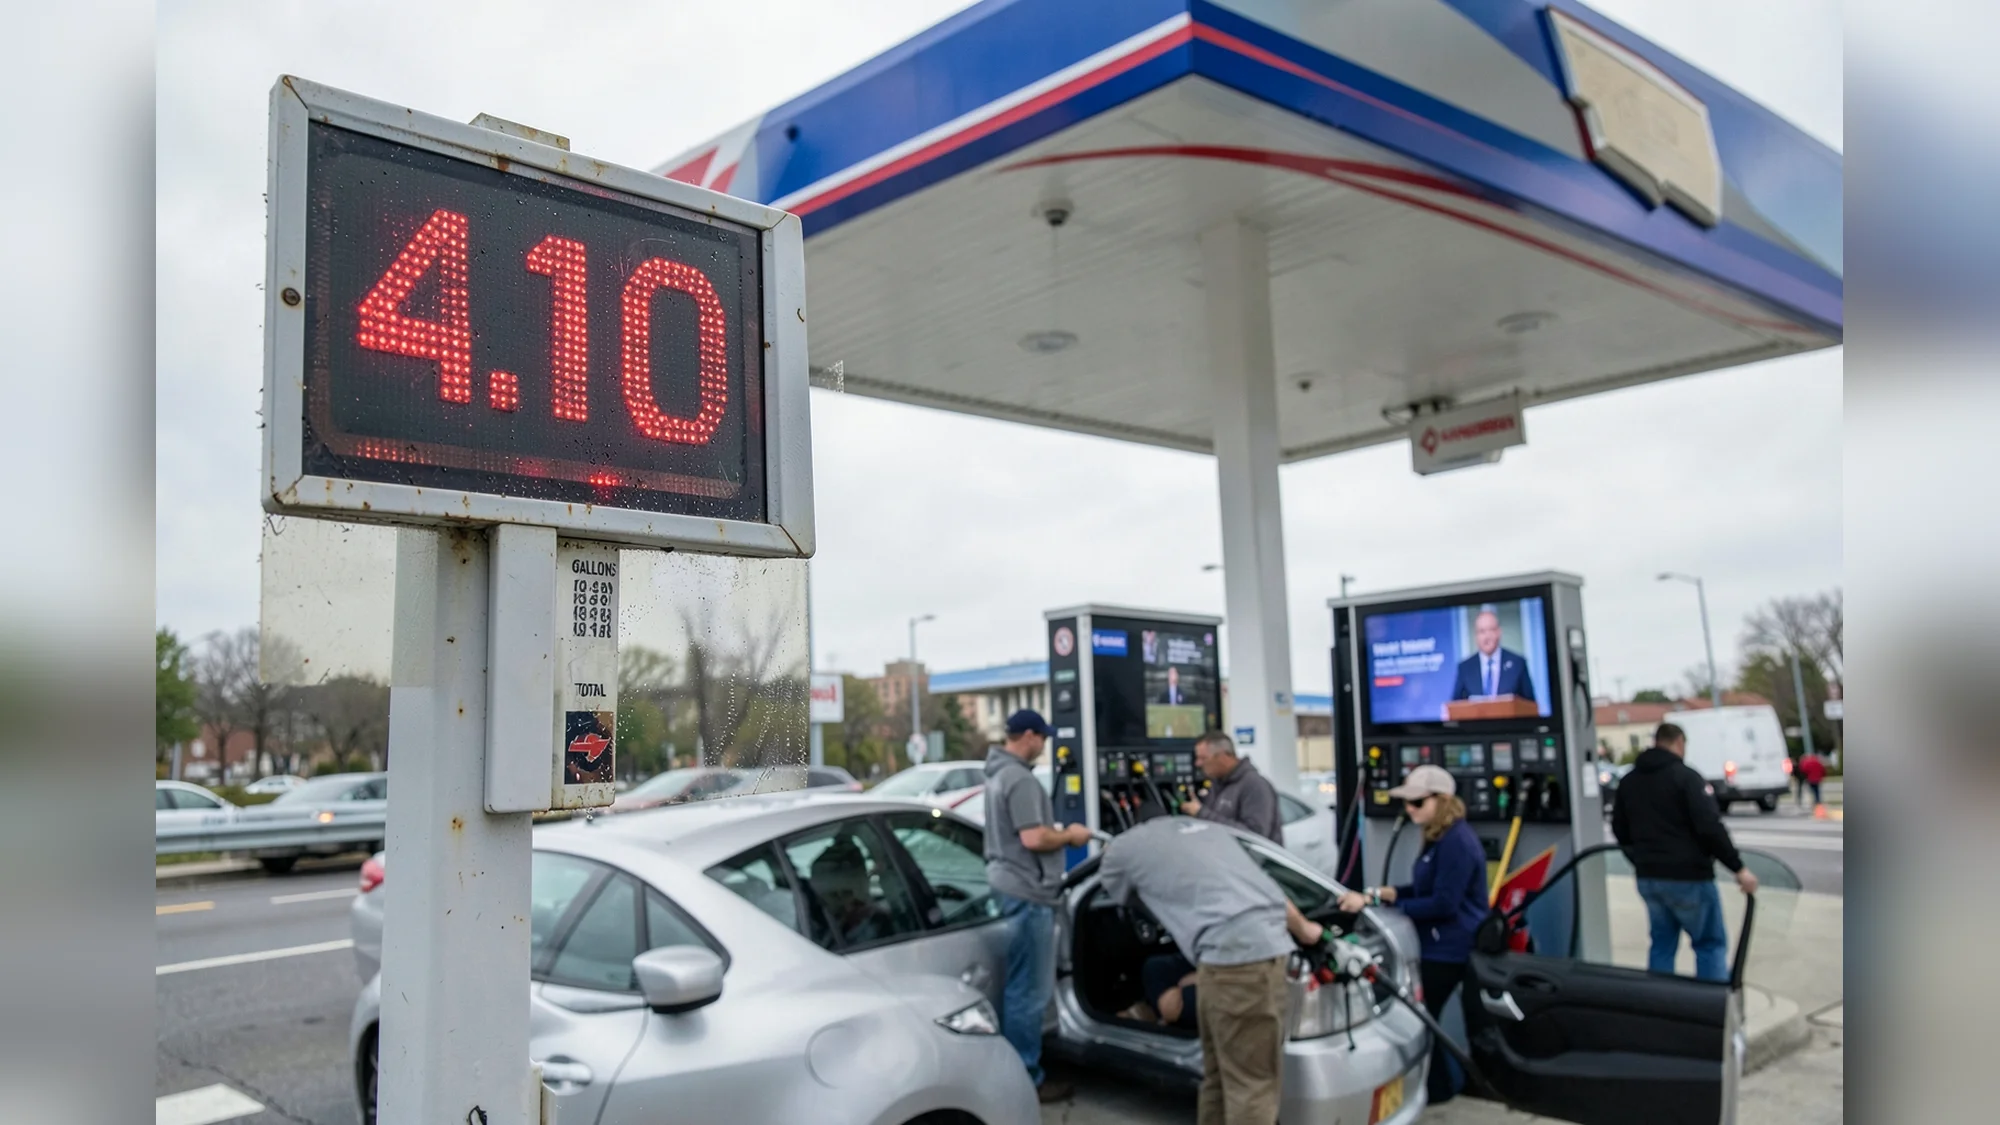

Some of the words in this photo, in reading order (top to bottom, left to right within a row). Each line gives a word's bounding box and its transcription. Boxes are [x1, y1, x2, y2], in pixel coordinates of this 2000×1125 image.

[356, 208, 728, 446] 4.10
[571, 558, 617, 577] GALLONS
[574, 682, 607, 697] TOTAL
